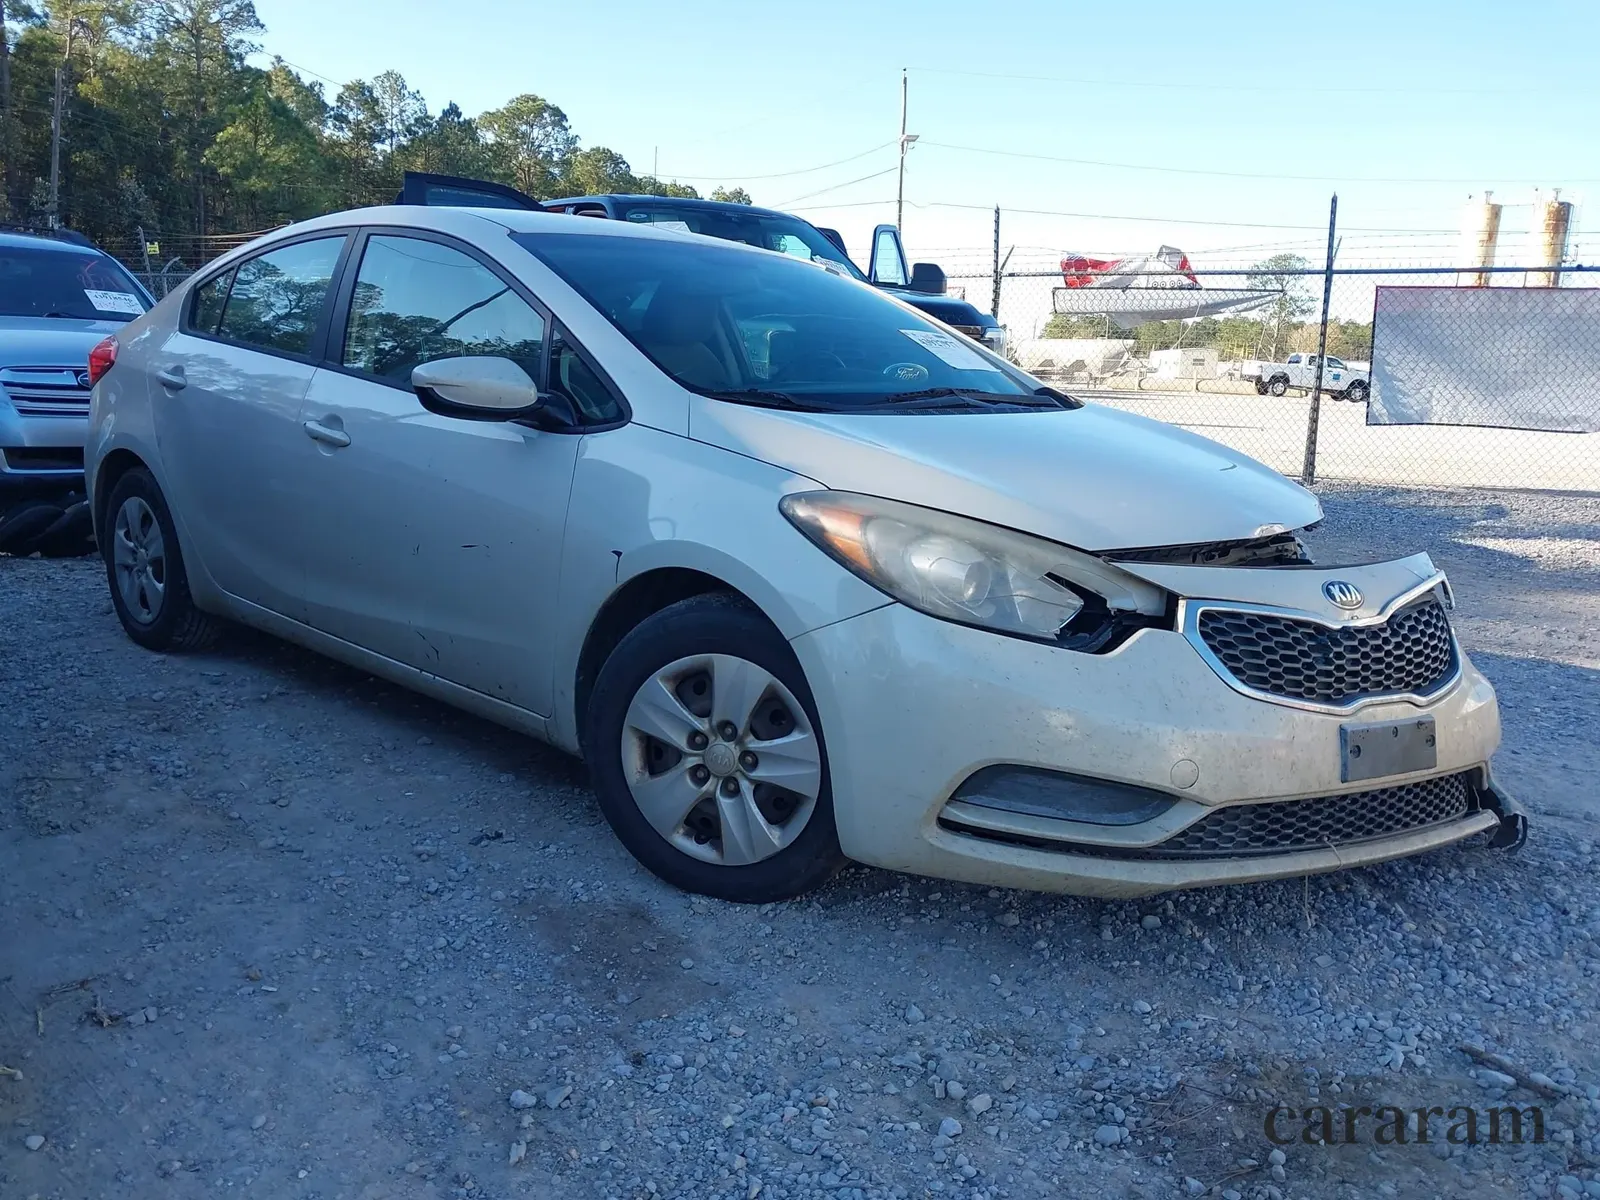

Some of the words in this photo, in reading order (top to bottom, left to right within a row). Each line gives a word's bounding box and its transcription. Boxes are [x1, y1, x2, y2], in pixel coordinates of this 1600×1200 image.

[894, 367, 920, 381] Ford
[1328, 584, 1362, 602] KIA
[710, 753, 731, 768] KIA
